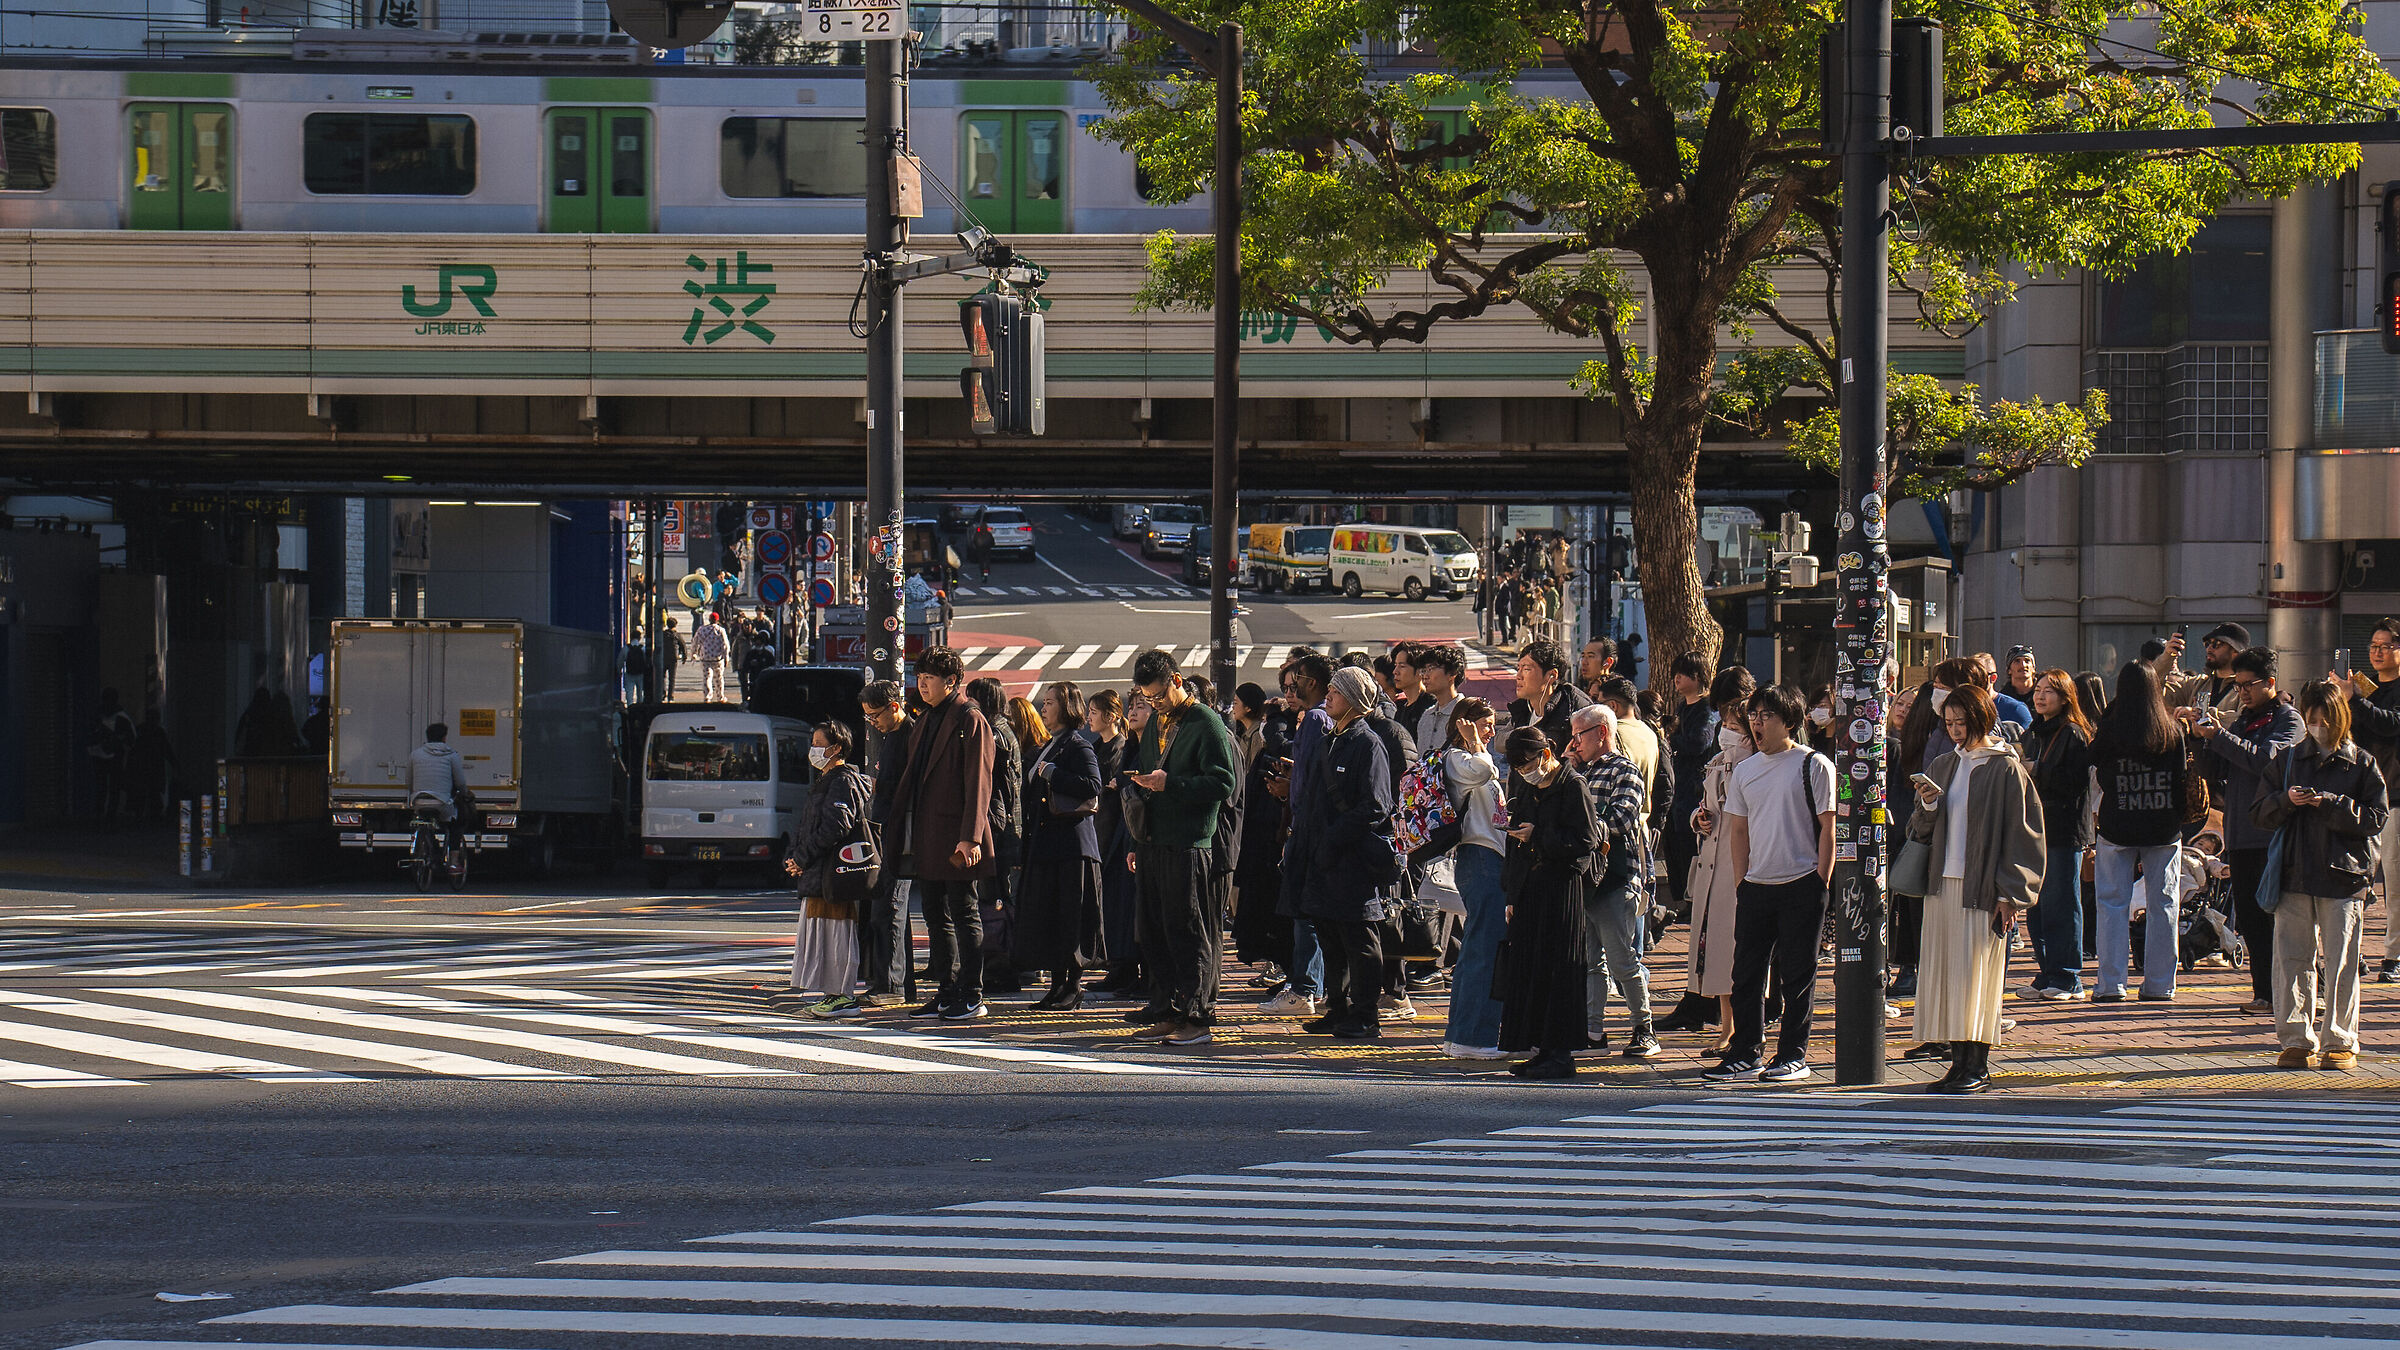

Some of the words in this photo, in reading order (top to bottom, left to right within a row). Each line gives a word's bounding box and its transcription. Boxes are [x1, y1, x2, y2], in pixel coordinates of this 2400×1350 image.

[402, 263, 499, 318] JR
[415, 322, 487, 336] JR東日本
